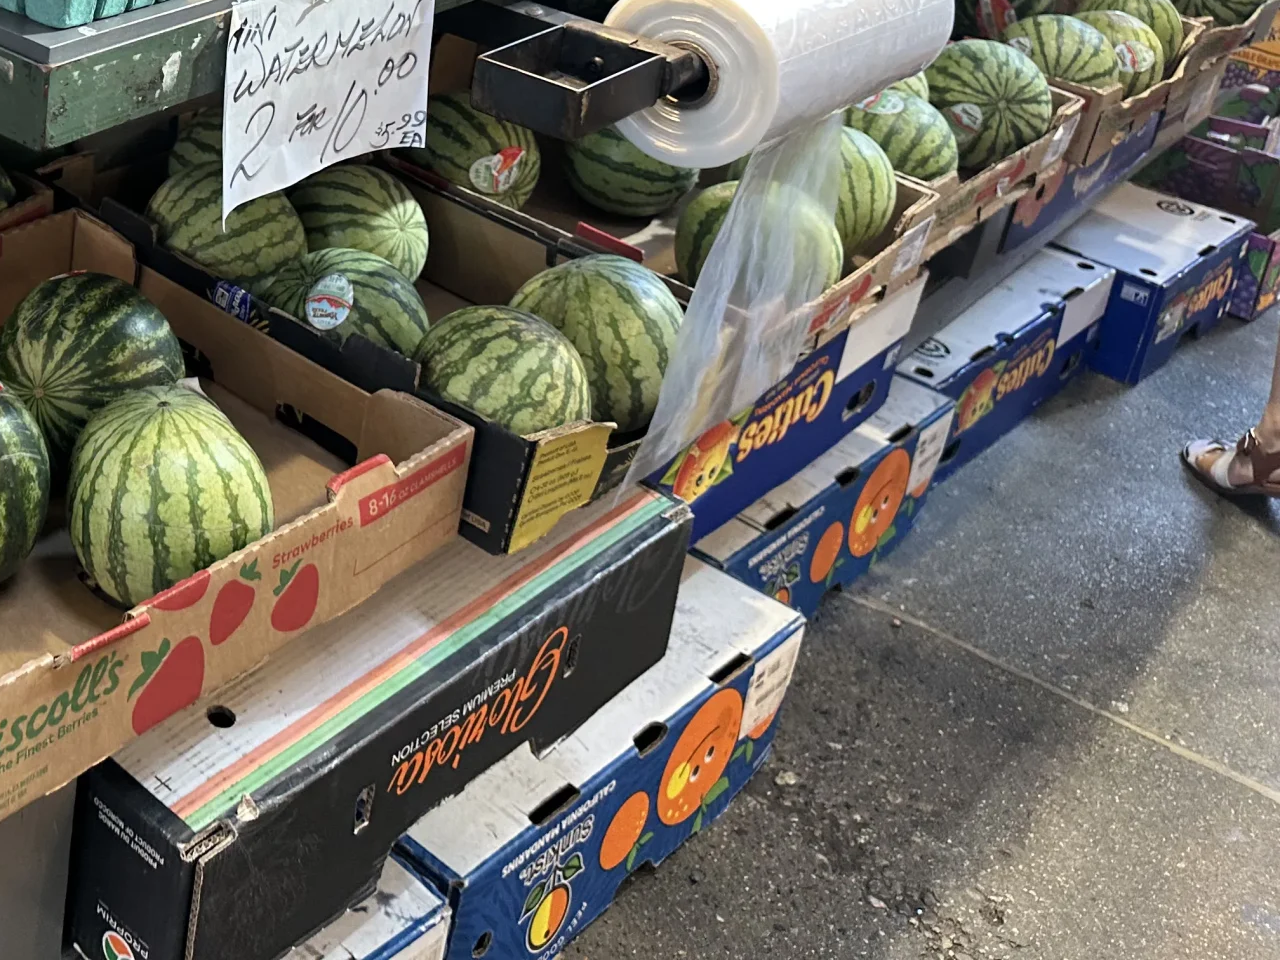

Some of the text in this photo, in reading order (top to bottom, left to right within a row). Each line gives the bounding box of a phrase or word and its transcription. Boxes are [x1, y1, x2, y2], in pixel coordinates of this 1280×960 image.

[230, 100, 275, 189] 2
[996, 339, 1055, 402] Cuties
[736, 370, 835, 463] Cuties
[367, 490, 398, 517] 8-16
[409, 456, 460, 494] CLAMSHELLS
[272, 515, 355, 570] Strawberries
[13, 734, 55, 770] Finest
[55, 712, 99, 746] Berries
[390, 668, 517, 767] PREMIUM SELECTION
[501, 780, 616, 878] CALIFORNIA MANDARINS
[520, 814, 596, 886] Sunkist
[95, 903, 150, 959] PROPRIM
